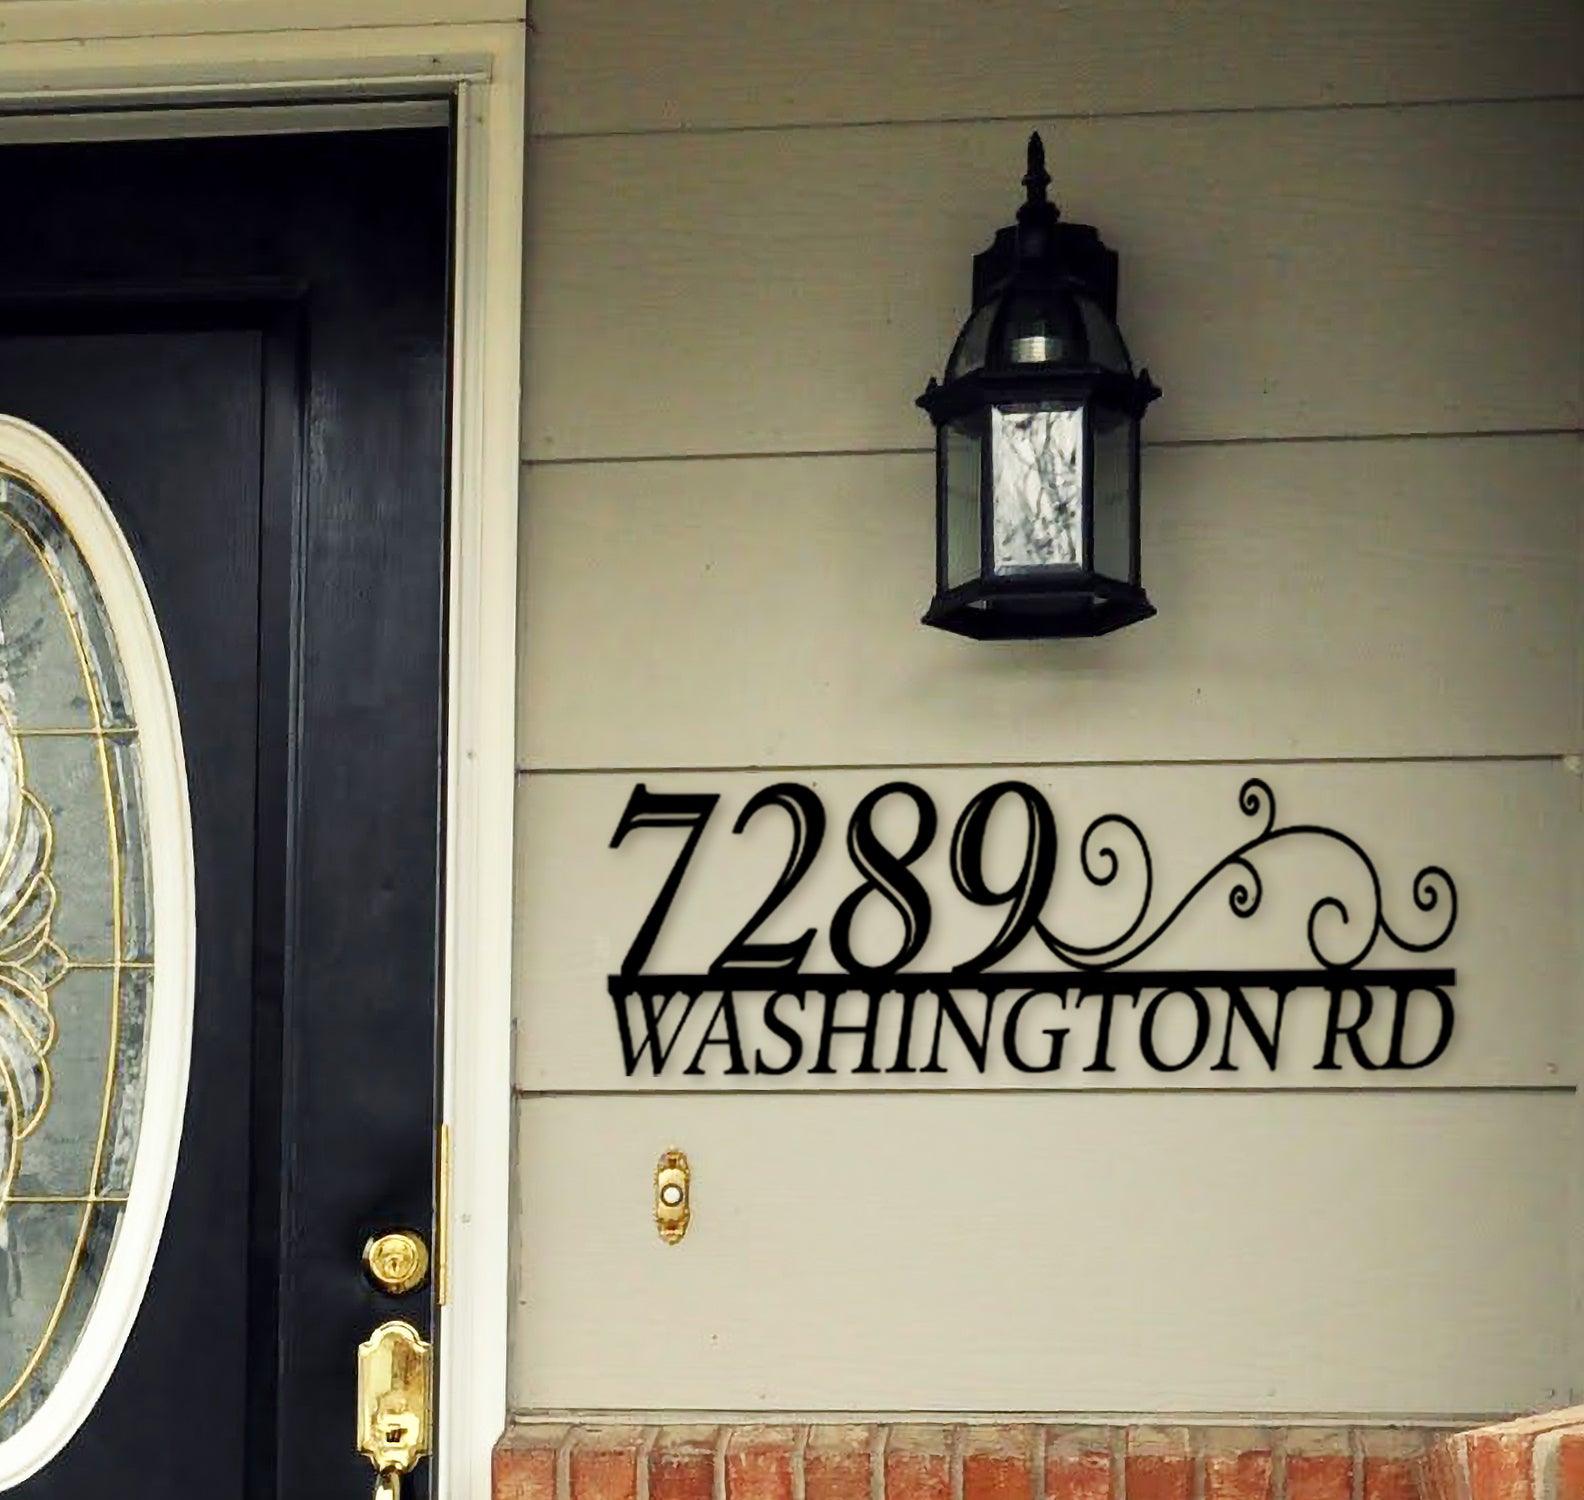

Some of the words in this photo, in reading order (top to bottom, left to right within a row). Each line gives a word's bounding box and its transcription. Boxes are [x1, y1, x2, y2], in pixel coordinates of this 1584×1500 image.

[609, 780, 1058, 975] 7289
[611, 985, 1288, 1078] WASHINGTON
[1315, 985, 1457, 1072] RD
